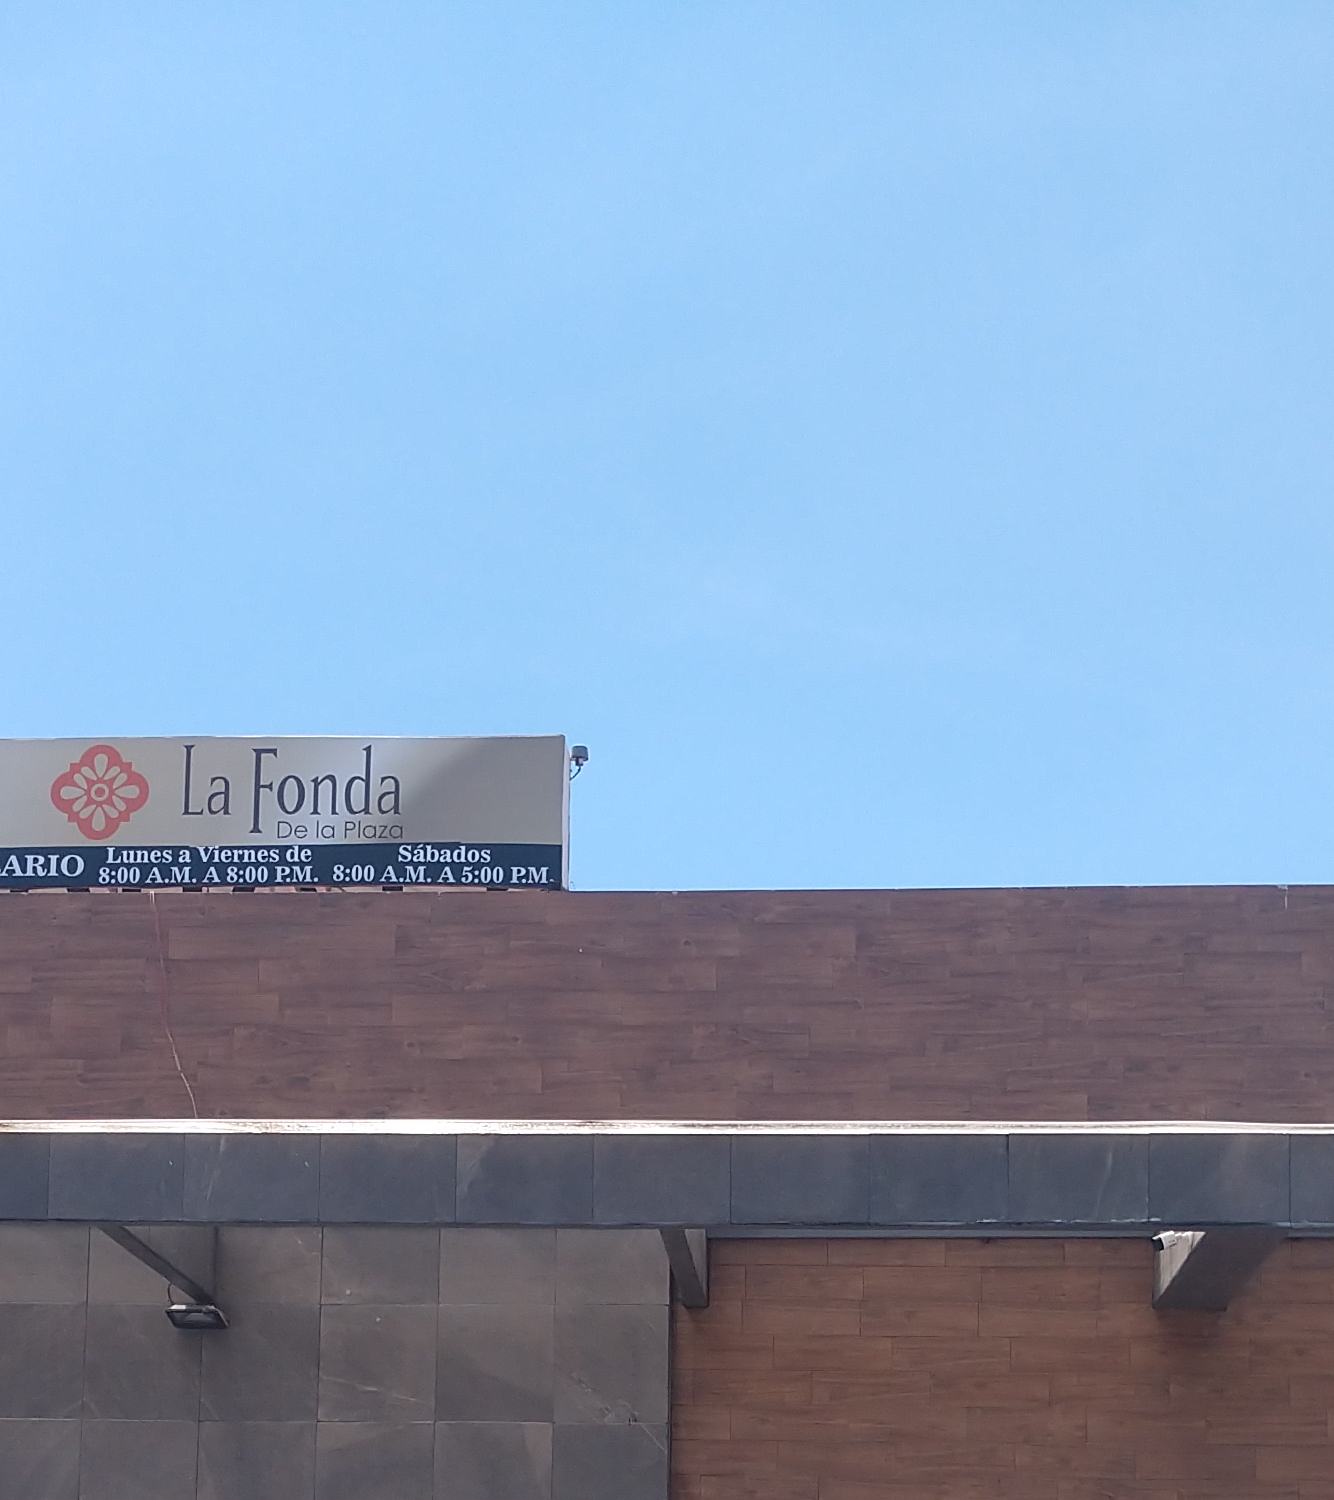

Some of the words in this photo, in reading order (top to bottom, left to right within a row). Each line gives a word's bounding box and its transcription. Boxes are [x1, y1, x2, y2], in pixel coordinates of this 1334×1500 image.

[182, 744, 231, 815] La
[249, 744, 401, 834] Fonda
[277, 821, 308, 839] De
[316, 821, 335, 839] la
[344, 821, 403, 839] Plaza
[105, 846, 171, 864] Lunes
[178, 850, 191, 863] a
[196, 845, 279, 863] Viernes
[285, 845, 312, 862] de
[397, 845, 491, 863] Sábados
[98, 866, 141, 884] 8:00
[145, 866, 197, 884] A.M.
[201, 866, 221, 883] A
[226, 866, 268, 883] 8:00
[274, 865, 319, 883] P.M.
[332, 865, 378, 883] 8:00
[380, 865, 431, 883] A.M.
[438, 865, 456, 883] A
[461, 865, 504, 883] 5:00
